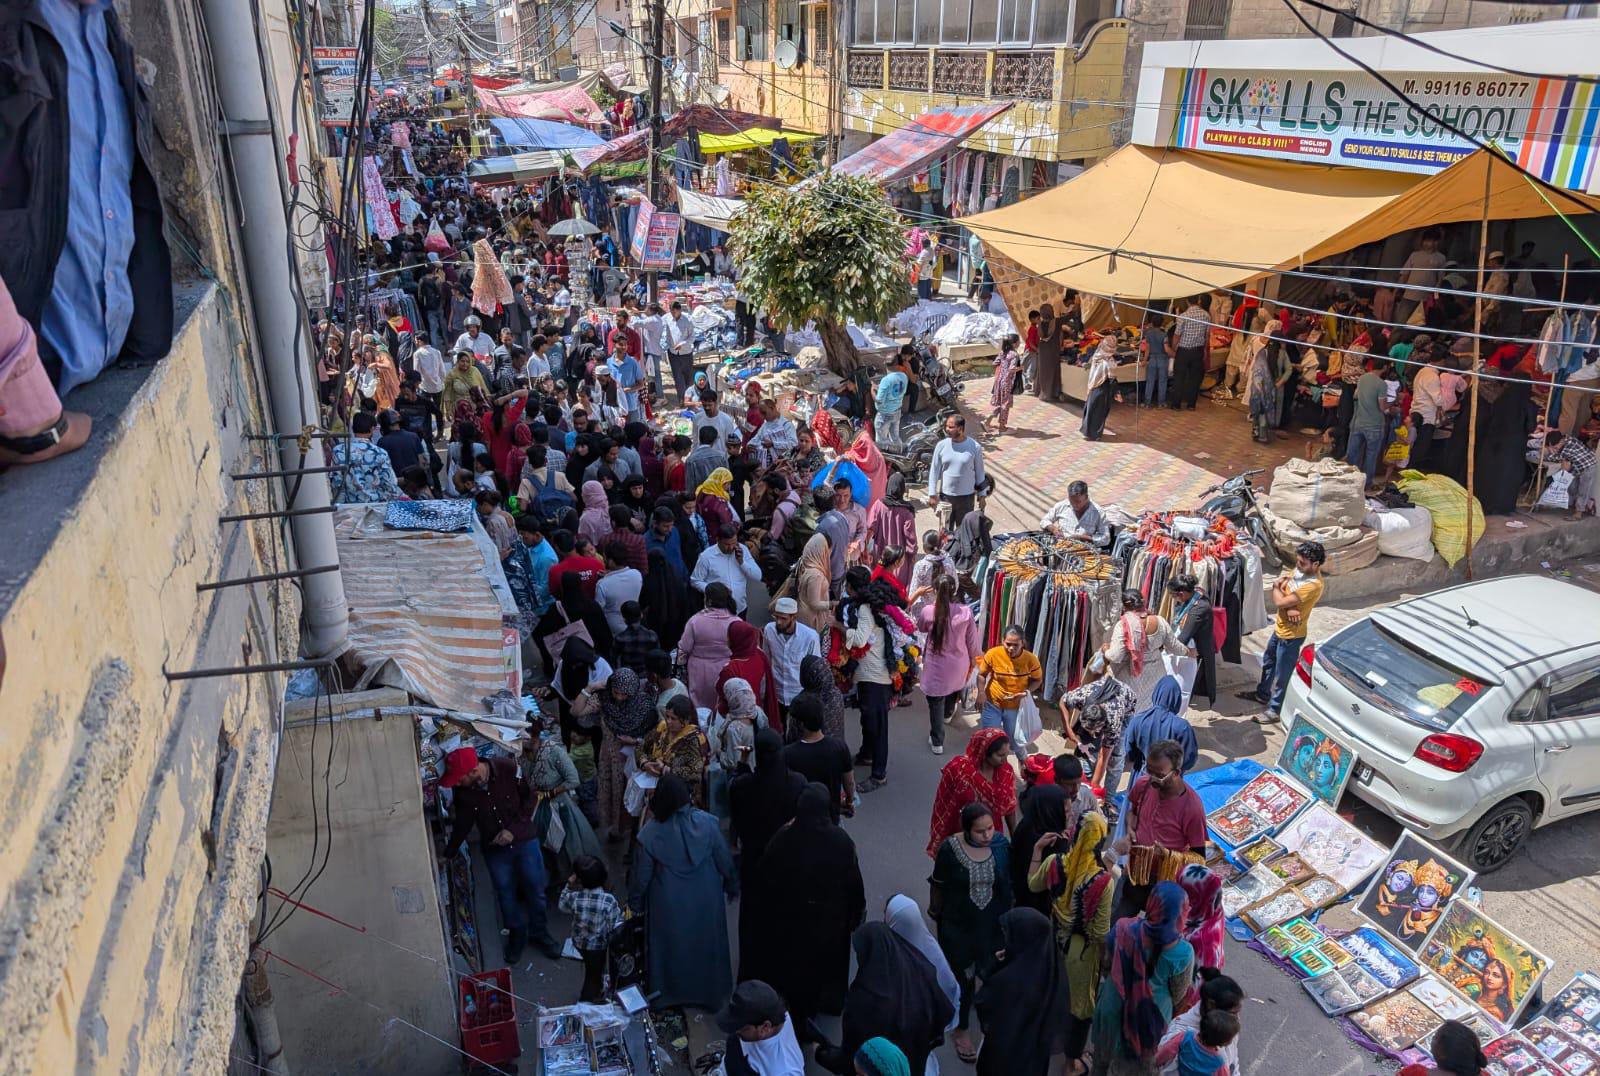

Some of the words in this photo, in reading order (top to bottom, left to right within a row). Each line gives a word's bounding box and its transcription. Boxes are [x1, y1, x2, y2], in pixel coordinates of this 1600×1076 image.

[1403, 80, 1419, 95] M.
[1424, 80, 1471, 96] 99116
[1476, 81, 1529, 98] 86077
[1352, 100, 1400, 135] THE
[1403, 102, 1520, 143] SCHOOL
[1206, 132, 1237, 144] PLAYWAY
[1238, 135, 1246, 144] to
[1247, 136, 1272, 147] CLASS
[1299, 139, 1328, 147] ENGLISH
[1299, 146, 1326, 154] MEDIUM
[1344, 143, 1358, 153] SEND
[1358, 145, 1373, 155] YOUR
[1373, 146, 1389, 156] CHILD
[1390, 148, 1398, 157] TO
[1398, 148, 1418, 160] SKILLS
[1417, 150, 1422, 160] &
[1423, 151, 1435, 161] SEE
[1436, 152, 1451, 163] THEM
